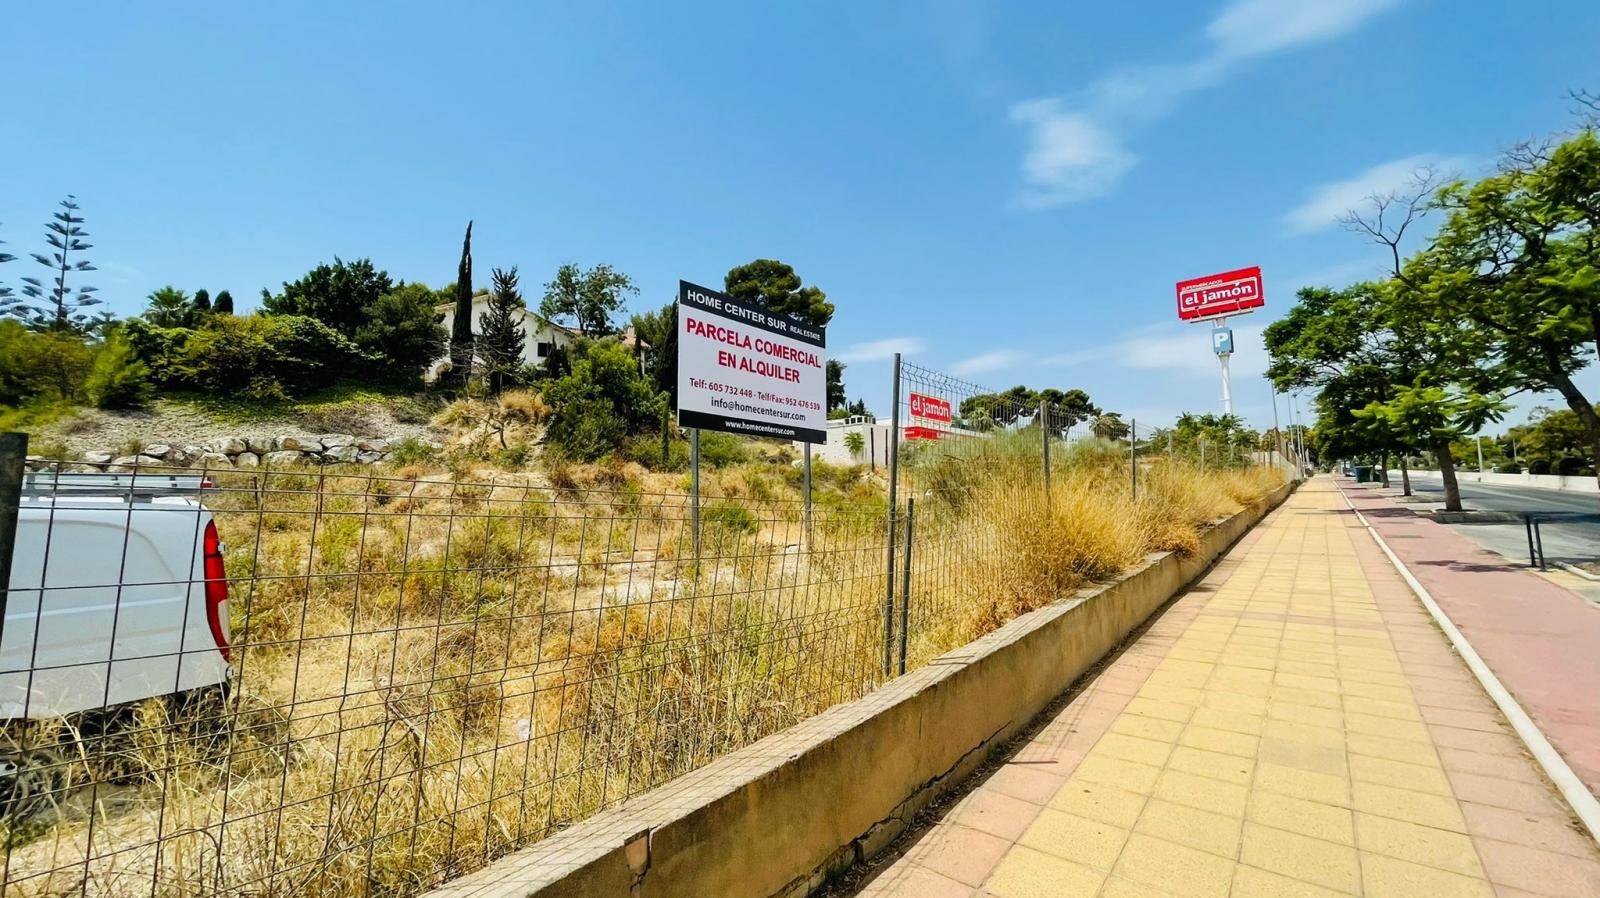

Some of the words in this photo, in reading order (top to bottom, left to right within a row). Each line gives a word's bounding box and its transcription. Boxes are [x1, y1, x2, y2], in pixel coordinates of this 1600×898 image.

[1185, 293, 1199, 305] el
[1202, 282, 1252, 304] jamón
[687, 289, 722, 310] HOME
[724, 303, 765, 325] CENTER
[767, 317, 787, 332] SUR
[789, 325, 803, 336] REAL
[803, 329, 821, 341] ESTATE
[686, 317, 752, 351] PARCELA
[755, 338, 822, 368] COMERCIAL
[1214, 332, 1228, 348] P
[718, 350, 737, 369] EN
[739, 357, 800, 383] ALQUILER
[689, 377, 707, 389] Telf:
[708, 382, 723, 392] 605
[724, 385, 738, 396] 732
[739, 387, 753, 398] 448
[758, 391, 785, 405] Telf/Fax:
[785, 397, 797, 407] 952
[797, 399, 809, 409] 476
[711, 396, 806, 421] info@homecentersur.com
[912, 397, 921, 411] el
[922, 398, 949, 417] jamón
[725, 420, 795, 436] www.homecentersur.com
